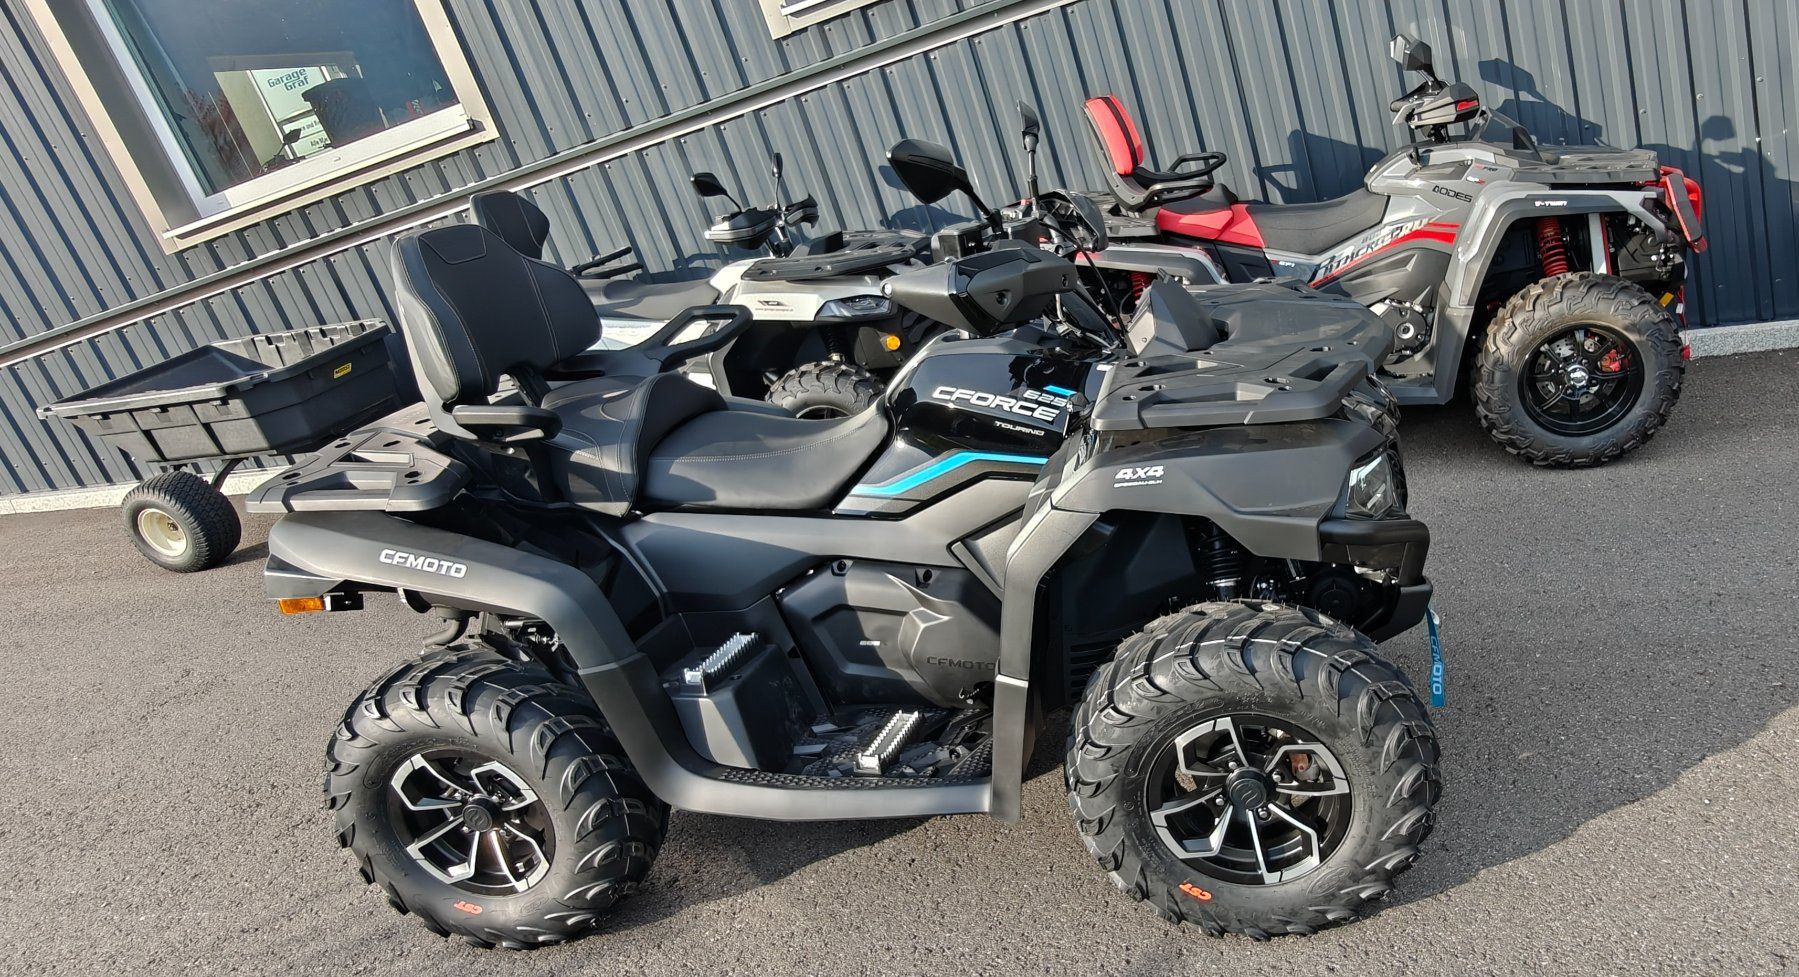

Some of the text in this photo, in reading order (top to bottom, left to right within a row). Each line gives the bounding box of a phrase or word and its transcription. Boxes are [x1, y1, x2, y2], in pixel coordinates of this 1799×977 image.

[267, 68, 307, 88] Garage
[284, 76, 309, 91] Graf
[932, 386, 1062, 421] CFORCE
[1023, 389, 1068, 407] 625
[994, 421, 1045, 436] TOURING
[379, 548, 467, 578] CFMOTO
[926, 656, 996, 671] CFMOTO
[1431, 635, 1443, 694] CFMOTO
[1179, 882, 1212, 901] CST
